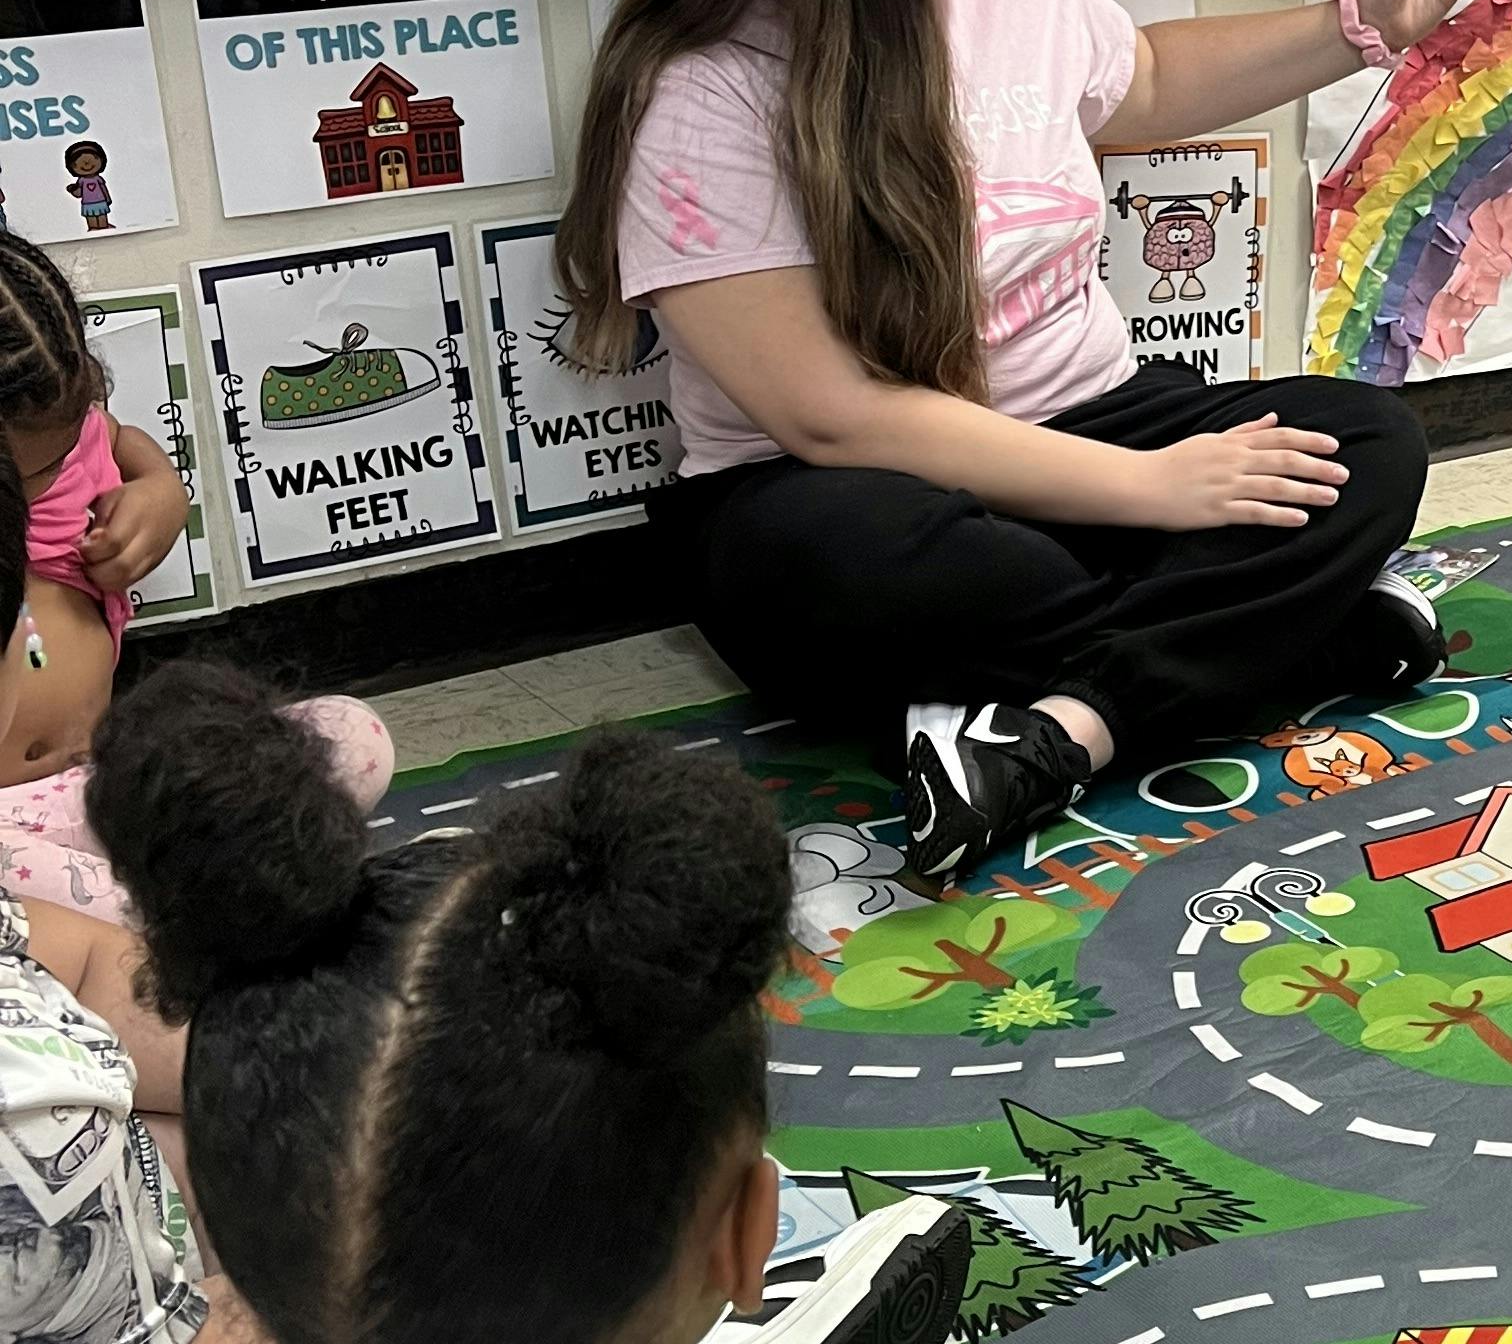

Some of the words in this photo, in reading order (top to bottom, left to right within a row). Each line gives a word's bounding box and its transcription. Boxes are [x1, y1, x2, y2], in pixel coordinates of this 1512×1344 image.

[224, 29, 287, 71] OF
[296, 18, 386, 67] THIS
[393, 7, 519, 57] PLACE
[1124, 307, 1244, 345] ROWING
[528, 399, 677, 448] WATCHIN
[264, 435, 454, 499] WALKING
[584, 439, 663, 479] EYES
[326, 487, 410, 535] FEET
